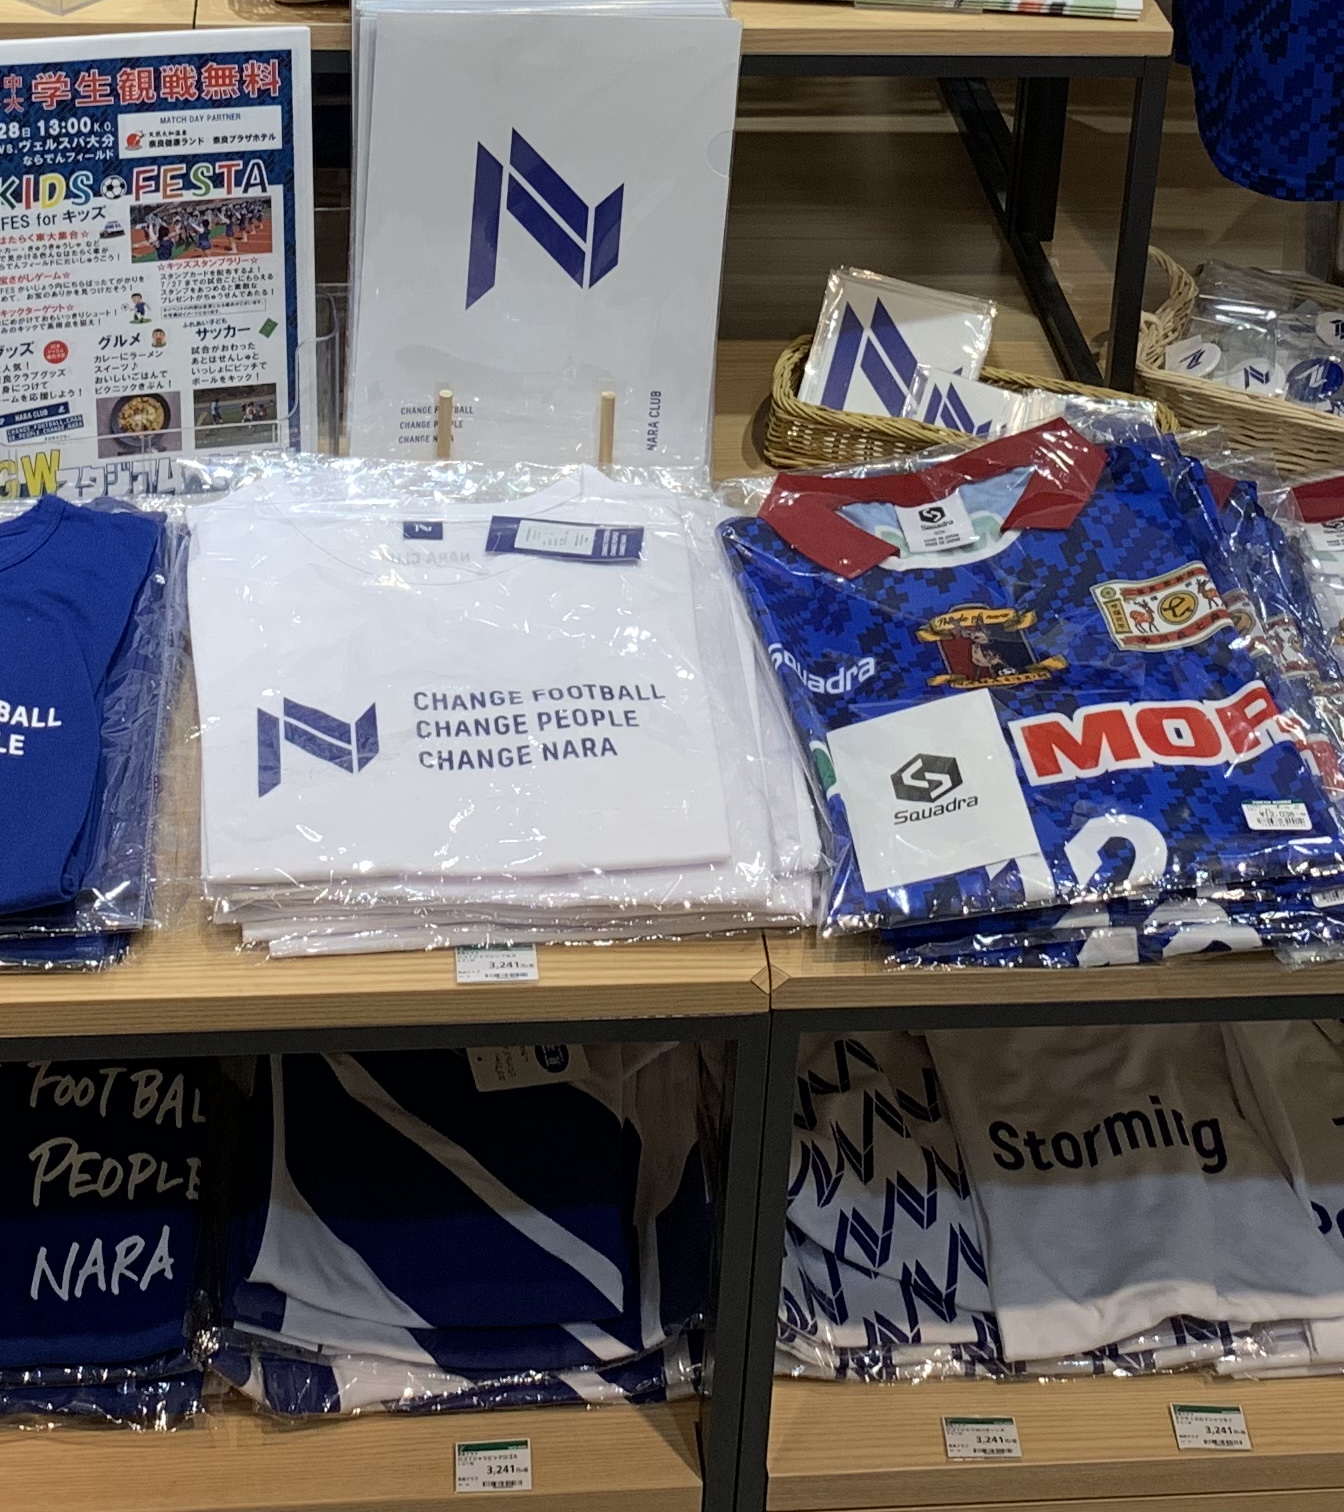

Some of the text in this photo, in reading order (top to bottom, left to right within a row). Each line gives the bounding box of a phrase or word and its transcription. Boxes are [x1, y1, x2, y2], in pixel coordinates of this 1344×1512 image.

[31, 59, 281, 111] 学生観戦無料
[37, 116, 92, 137] 13:00
[159, 113, 241, 124] MATCH DAY PARTNER
[133, 159, 269, 203] FESTA
[37, 213, 57, 226] for
[62, 205, 107, 224] キッズ
[98, 332, 142, 351] グルメ
[195, 324, 251, 342] サッカー
[400, 404, 433, 416] CHANGE
[650, 390, 662, 418] CLUB
[399, 419, 431, 430] CHANGE
[647, 420, 659, 451] NARA
[398, 433, 431, 445] CHANGE
[415, 682, 667, 711] CHANGE FOOTBALL
[416, 707, 641, 740] CHANGE PEOPLE
[419, 736, 619, 772] CHANGE NARA
[893, 792, 979, 827] Squadra
[27, 1060, 207, 1128] FOOTBAL
[29, 1136, 204, 1208] PEOPLE
[29, 1225, 175, 1302] NARA
[486, 1464, 516, 1475] 3,241
